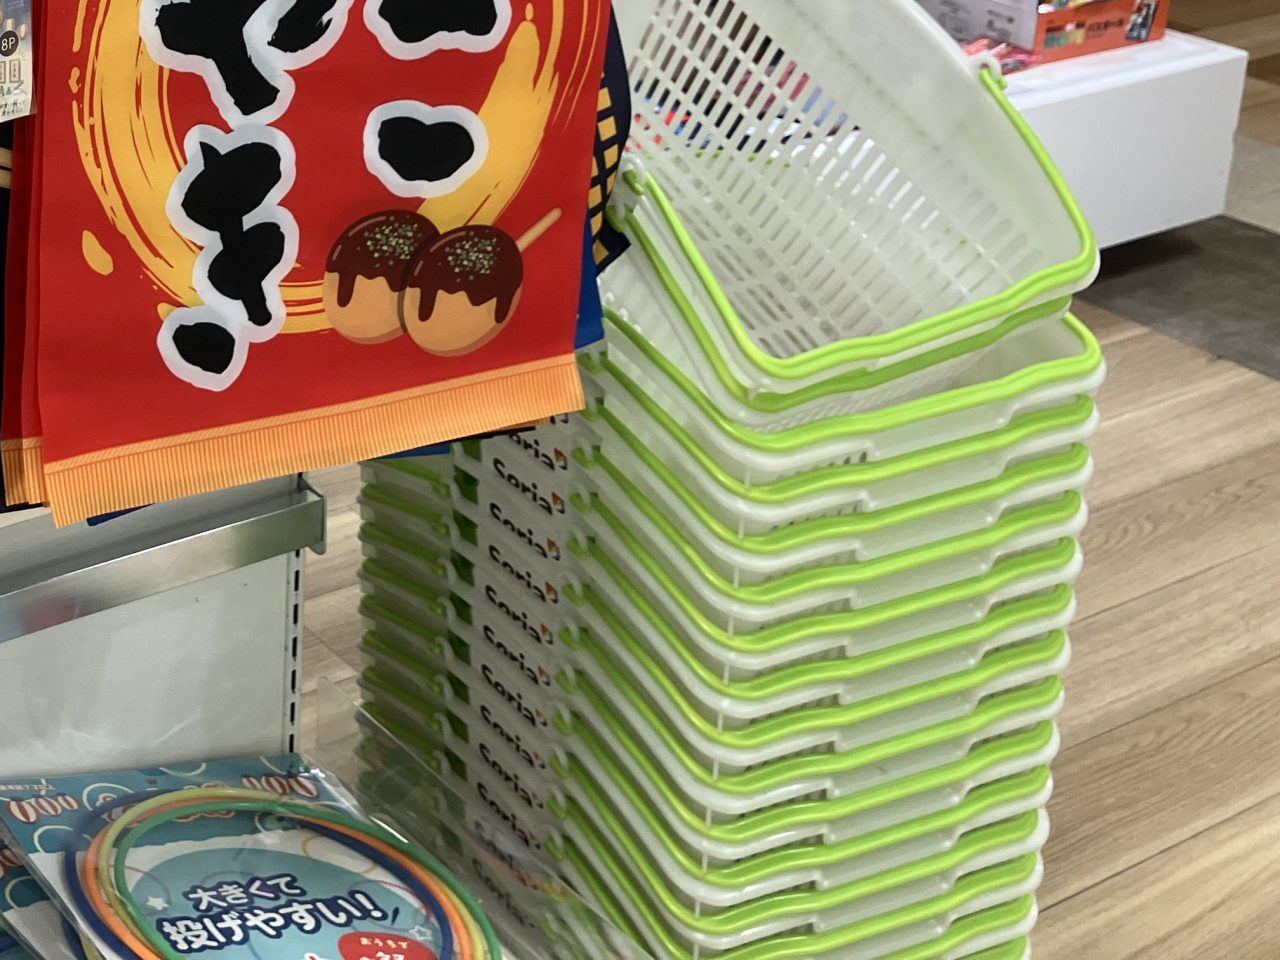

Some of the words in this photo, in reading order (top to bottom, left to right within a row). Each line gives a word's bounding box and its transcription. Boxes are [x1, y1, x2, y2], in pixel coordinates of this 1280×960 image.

[0, 37, 17, 52] 8P
[188, 874, 303, 912] 大きくて
